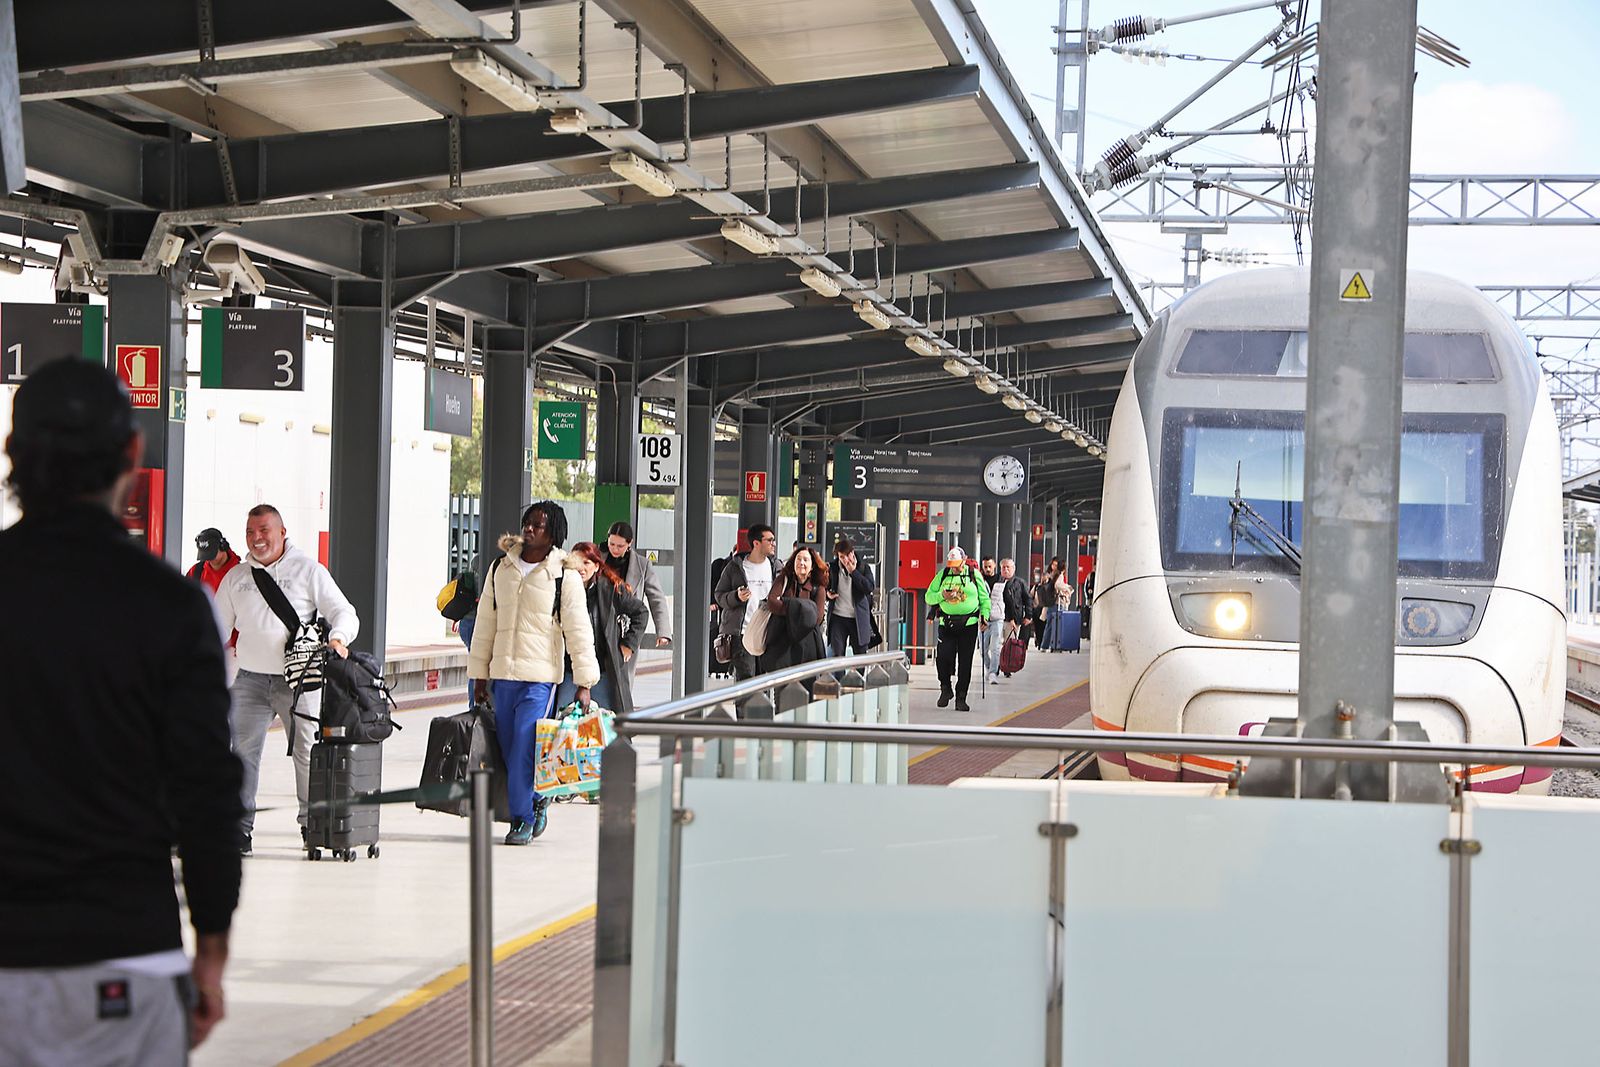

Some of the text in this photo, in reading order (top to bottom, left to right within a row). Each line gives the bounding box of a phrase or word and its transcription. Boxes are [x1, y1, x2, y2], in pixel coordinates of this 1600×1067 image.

[68, 307, 81, 316] Vía
[228, 312, 242, 321] Vía
[7, 343, 28, 380] 1
[274, 349, 294, 388] 3
[129, 393, 157, 404] TINTOR
[640, 436, 671, 458] 108
[649, 460, 676, 483] 5 494
[854, 465, 867, 489] 3
[1071, 517, 1079, 531] 3
